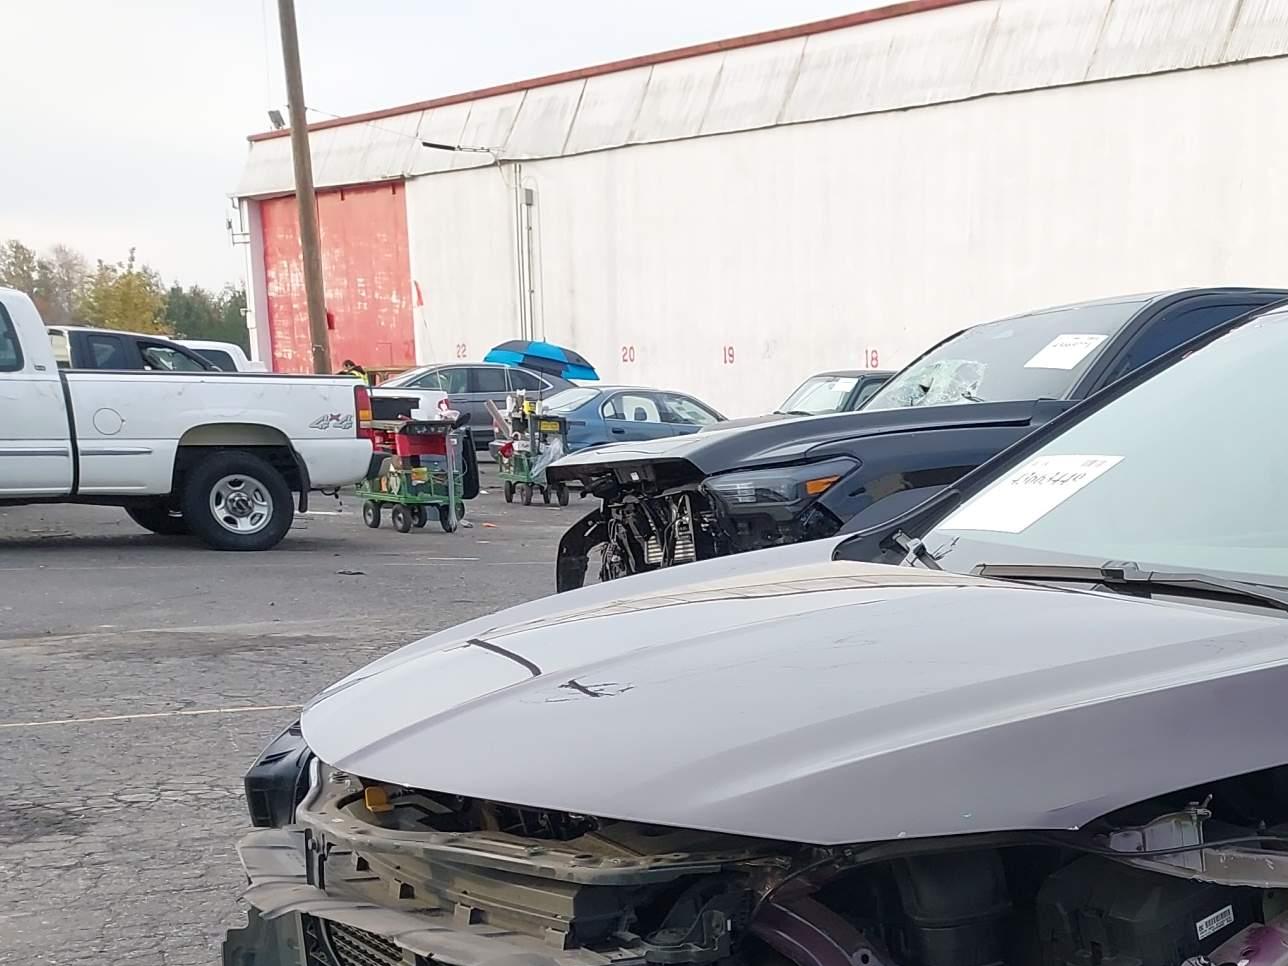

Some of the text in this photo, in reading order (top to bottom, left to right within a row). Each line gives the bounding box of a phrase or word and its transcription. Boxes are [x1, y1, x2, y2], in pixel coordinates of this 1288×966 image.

[456, 343, 467, 358] 22
[622, 346, 635, 362] 20
[723, 346, 735, 364] 19
[865, 349, 879, 368] 18
